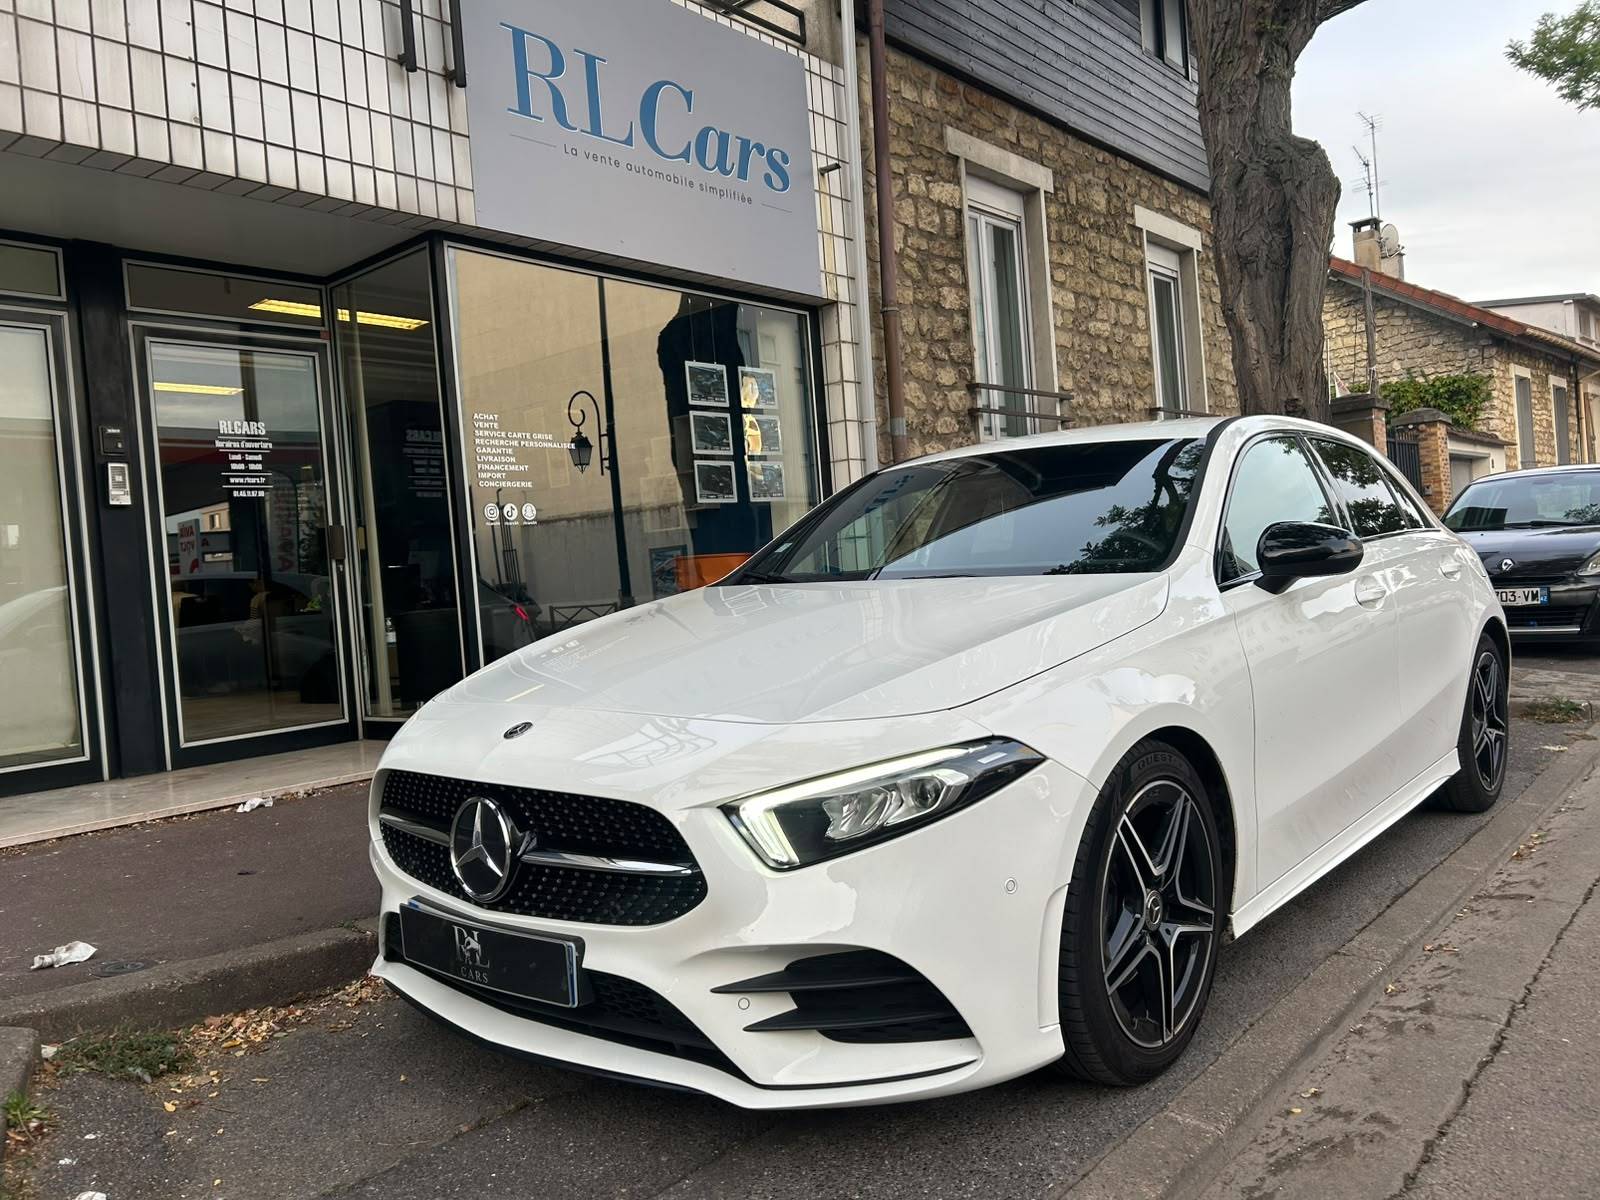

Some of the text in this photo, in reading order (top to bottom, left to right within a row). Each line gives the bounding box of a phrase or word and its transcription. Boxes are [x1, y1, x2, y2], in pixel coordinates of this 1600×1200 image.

[499, 22, 791, 193] RLCars
[563, 143, 578, 157] La
[584, 150, 621, 168] vente
[626, 161, 694, 189] automobile
[473, 413, 498, 421] ACHAT
[219, 420, 266, 435] RLCARS
[473, 421, 498, 429] VENTE
[474, 430, 506, 438] SERVICE
[507, 432, 531, 440] CARTE
[475, 439, 519, 447] RECHERCHE
[476, 447, 513, 455] GARANTIE
[460, 967, 489, 984] CARS
